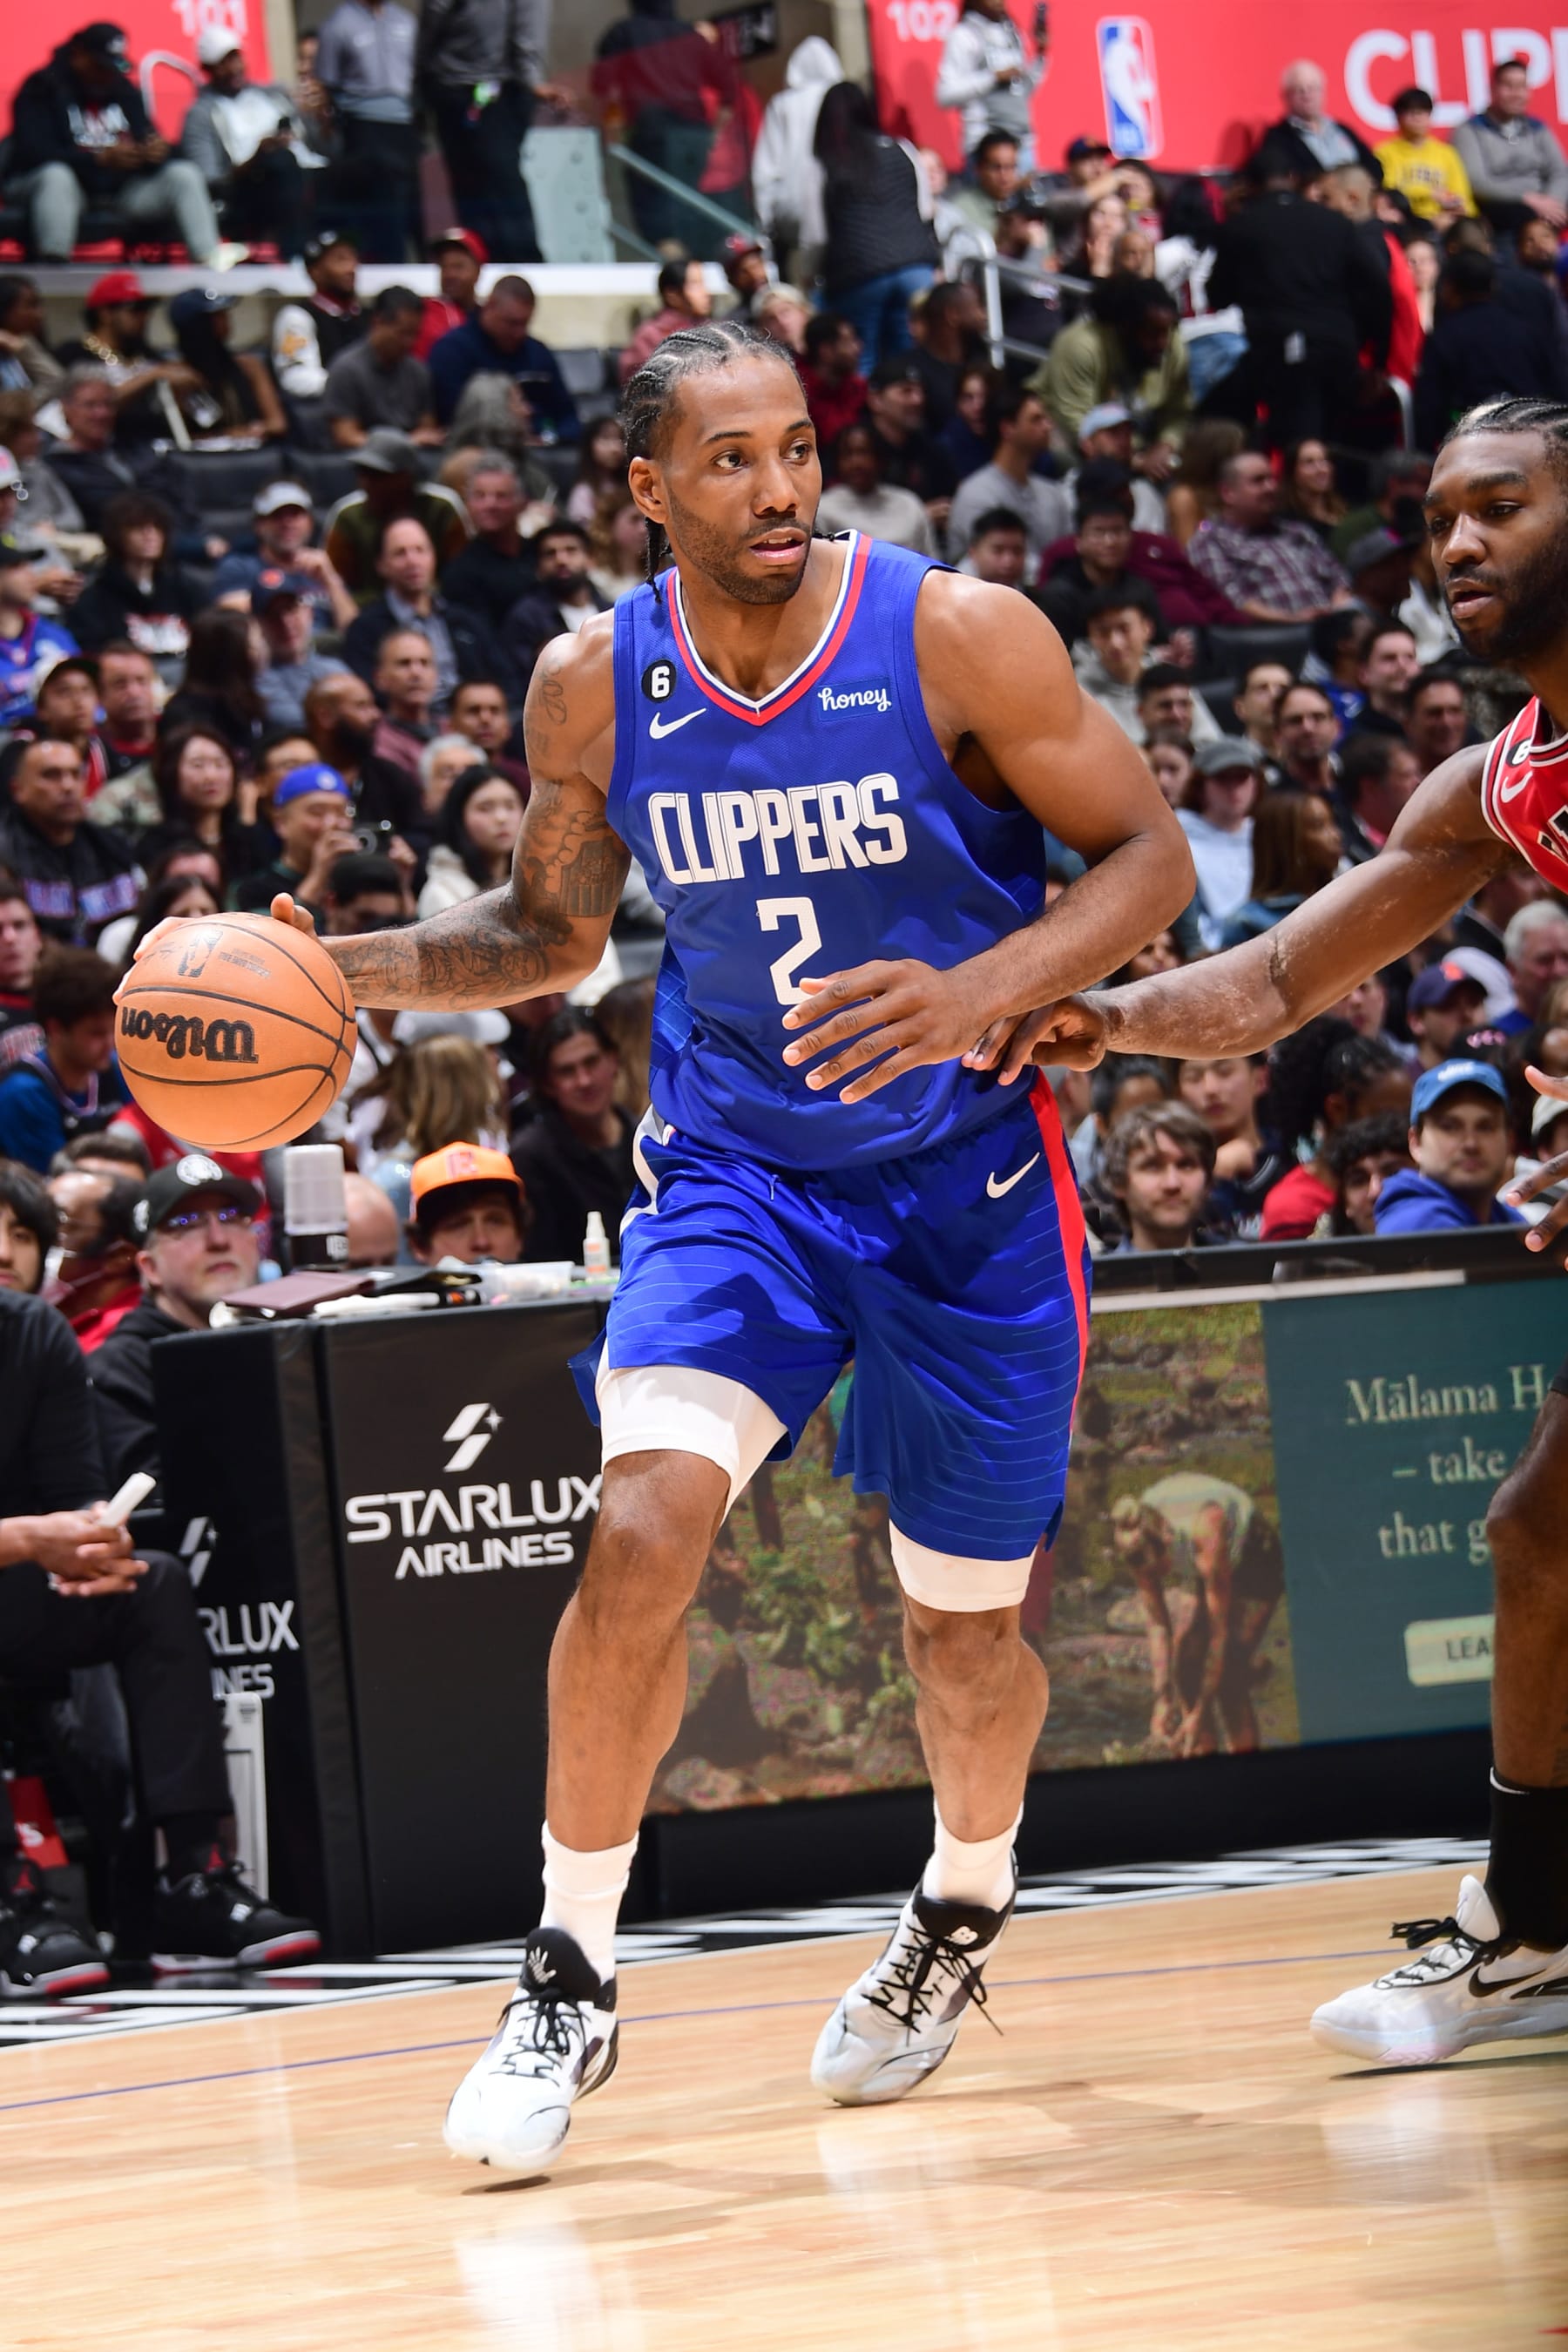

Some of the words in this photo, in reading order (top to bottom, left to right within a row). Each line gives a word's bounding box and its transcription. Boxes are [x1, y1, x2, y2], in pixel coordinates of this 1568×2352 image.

[650, 665, 670, 699] 6
[817, 686, 892, 712] honey
[647, 772, 909, 885] CLIPPERS
[755, 896, 822, 1006] 2
[121, 1006, 259, 1064] Wilson
[1346, 1374, 1499, 1424] Mālama
[1429, 1436, 1508, 1484] take
[345, 1473, 603, 1544] STARLUX
[394, 1531, 574, 1580] AIRLINES
[1378, 1511, 1456, 1558] that
